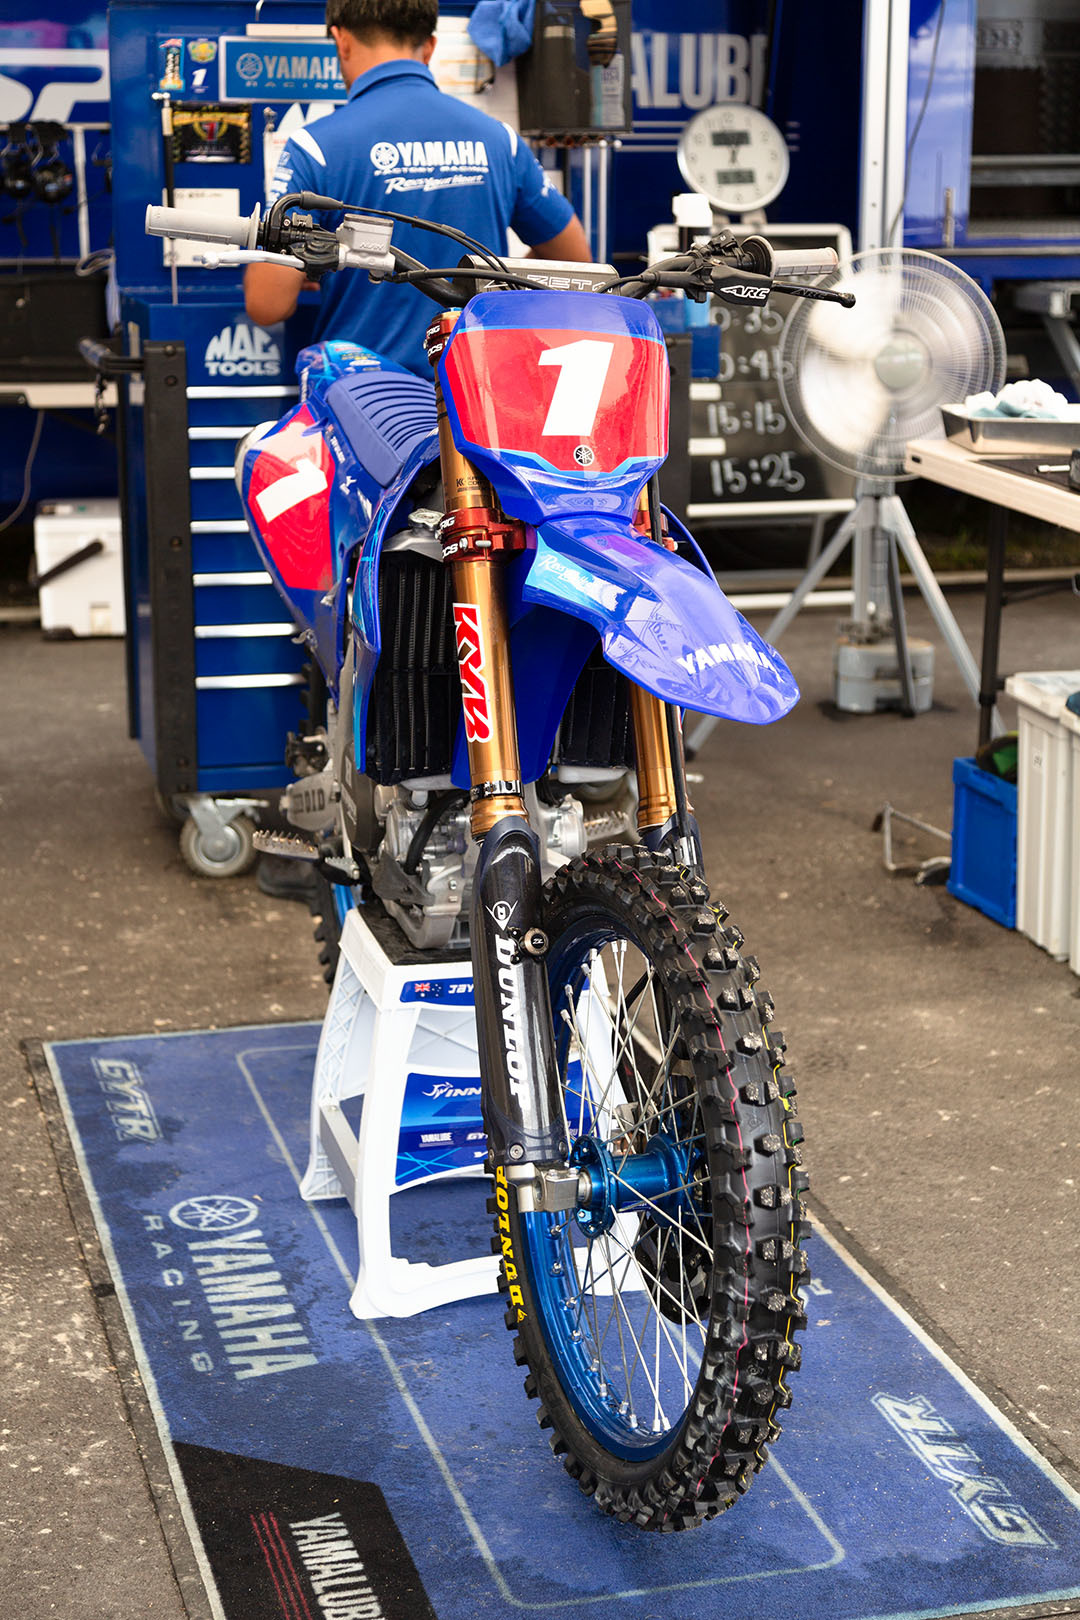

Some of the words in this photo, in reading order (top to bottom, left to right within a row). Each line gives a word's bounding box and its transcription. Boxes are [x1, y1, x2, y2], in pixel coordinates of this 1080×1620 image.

[396, 140, 488, 167] YAMAHA
[720, 285, 771, 300] ARC
[205, 323, 281, 361] MAC
[206, 361, 281, 377] TOOLS
[538, 339, 614, 436] 1
[706, 400, 787, 436] 15:15
[709, 450, 806, 497] 15:25
[453, 603, 493, 743] KYB
[677, 641, 785, 684] YAMAHA
[494, 933, 531, 1106] DUNLOP
[91, 1057, 163, 1142] GYTR
[496, 1165, 525, 1306] DUNLOP
[143, 1214, 214, 1373] RACING
[187, 1229, 319, 1381] YAMAHA
[871, 1391, 1059, 1550] GYTR
[289, 1511, 386, 1620] YAMALUB
